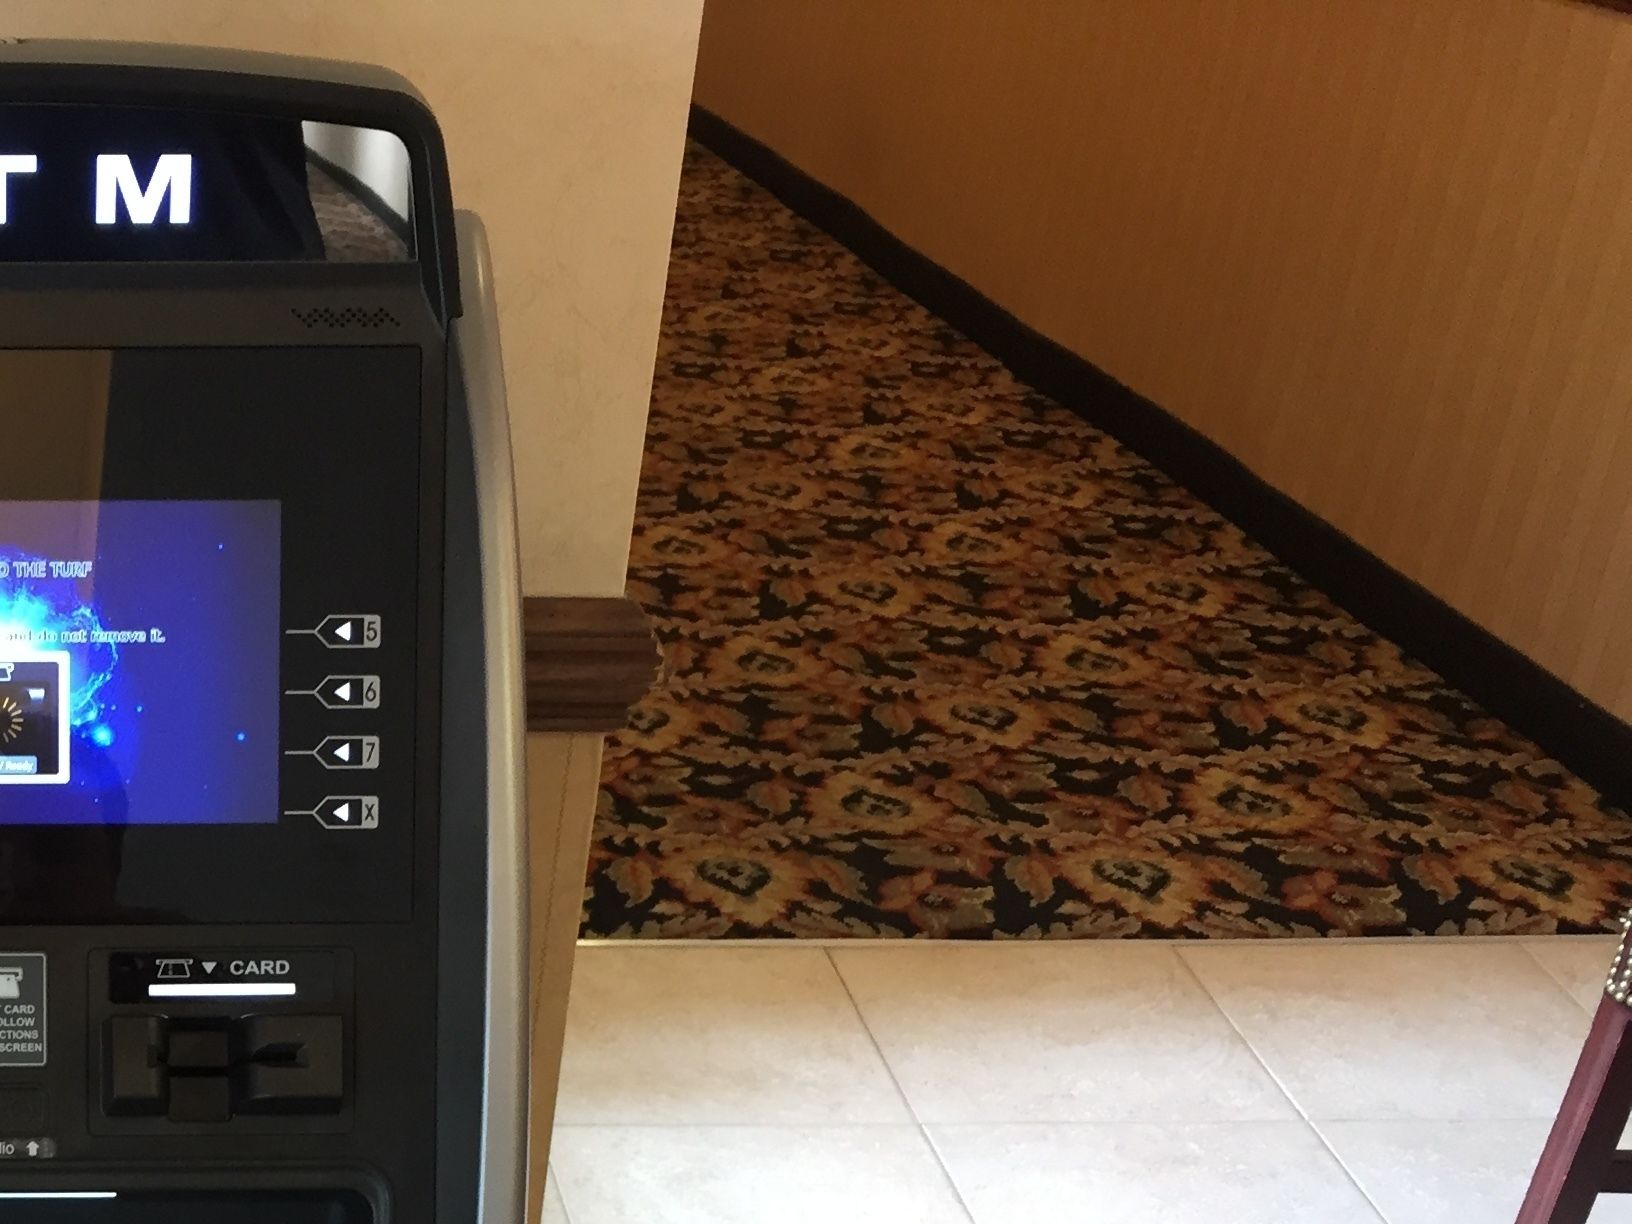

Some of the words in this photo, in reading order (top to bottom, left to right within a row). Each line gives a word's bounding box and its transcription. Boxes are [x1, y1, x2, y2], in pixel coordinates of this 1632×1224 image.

[13, 561, 46, 578] THE
[50, 560, 93, 578] TURF
[37, 629, 58, 642] do
[60, 629, 87, 643] not
[90, 630, 147, 643] remove
[150, 627, 166, 643] it.
[365, 621, 378, 642] 5
[364, 681, 377, 703] 6
[365, 742, 376, 763] 7
[229, 960, 290, 976] CARD
[4, 1004, 35, 1014] CARD
